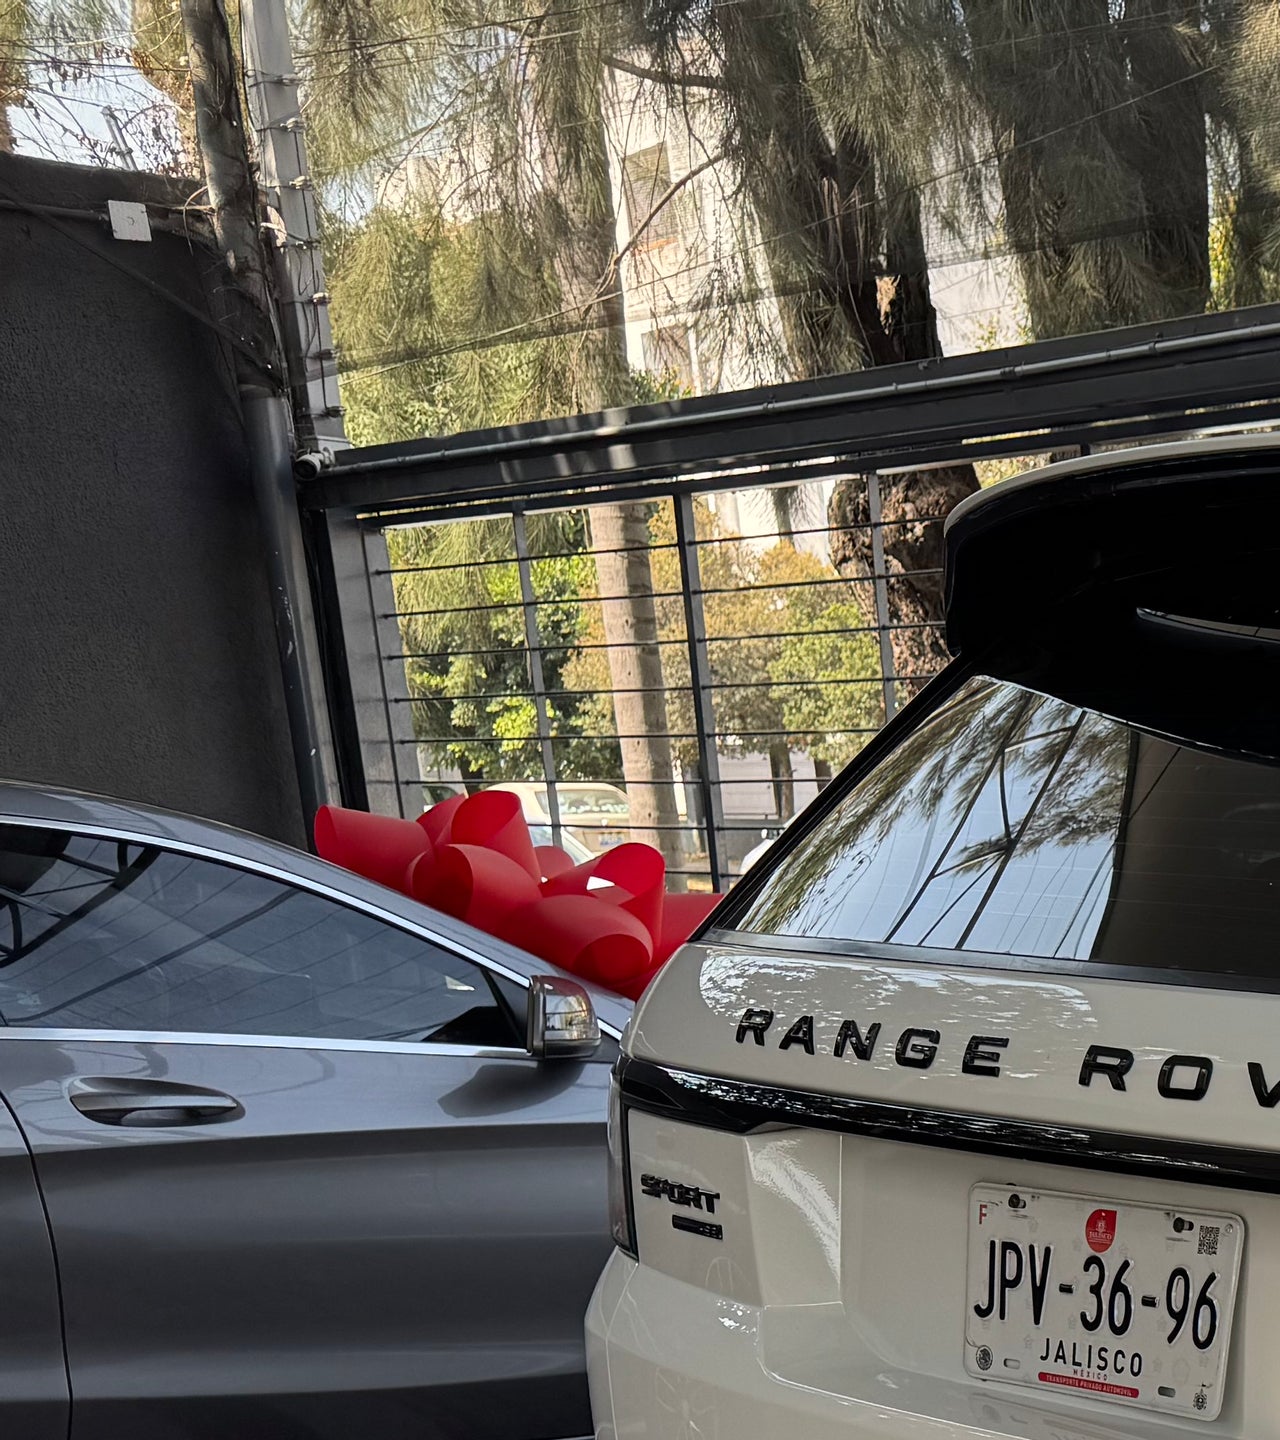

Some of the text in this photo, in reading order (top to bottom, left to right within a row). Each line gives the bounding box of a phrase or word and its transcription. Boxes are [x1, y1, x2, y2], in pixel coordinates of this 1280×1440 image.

[735, 1007, 1010, 1078] RANGE
[641, 1174, 720, 1214] SPORT
[973, 1239, 1219, 1350] JPV-36-96
[1040, 1338, 1142, 1377] JALISCO
[1046, 1375, 1079, 1387] TRANSPORTE
[1080, 1380, 1102, 1391] PRIVADO
